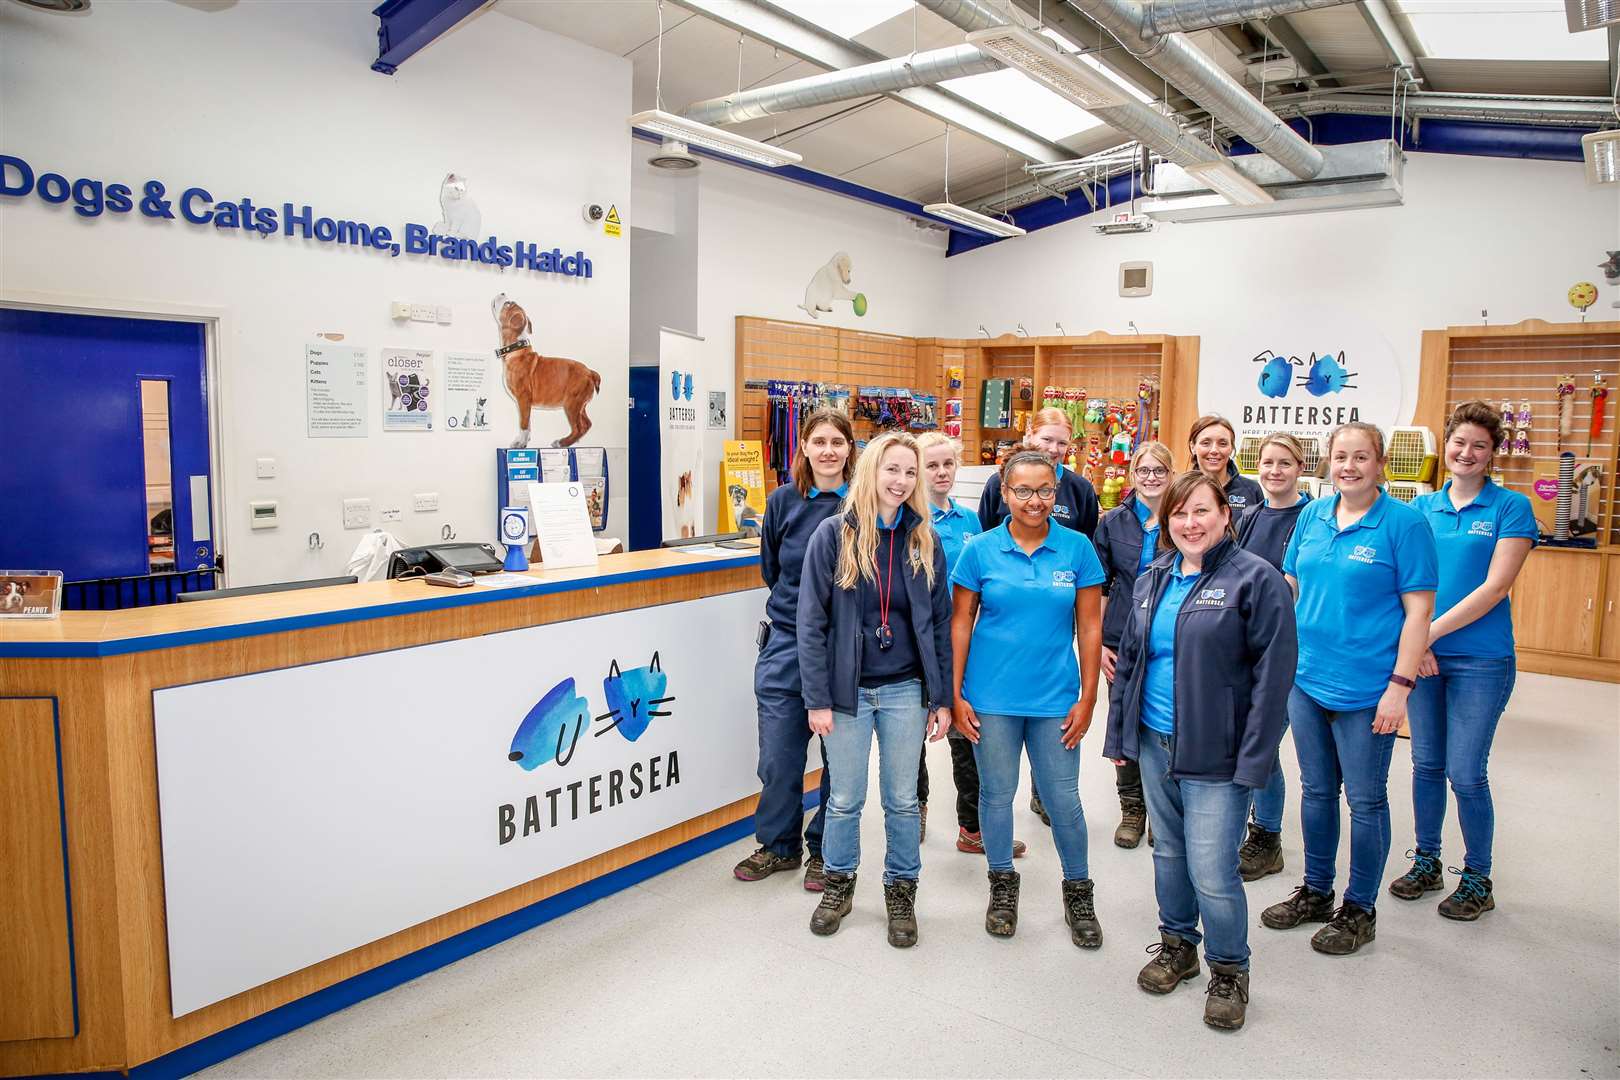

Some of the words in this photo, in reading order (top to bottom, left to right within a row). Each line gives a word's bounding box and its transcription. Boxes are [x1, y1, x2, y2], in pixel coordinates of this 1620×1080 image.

[0, 155, 133, 217] Dogs
[139, 180, 175, 219] &
[180, 187, 279, 234] Cats
[283, 203, 401, 257] Home,
[405, 222, 513, 268] Brands
[515, 240, 593, 278] Hatch
[387, 356, 424, 368] closer
[669, 407, 696, 421] BATTERSEA
[1242, 405, 1360, 425] BATTERSEA
[23, 606, 49, 614] PEANUT
[498, 750, 681, 846] BATTERSEA
